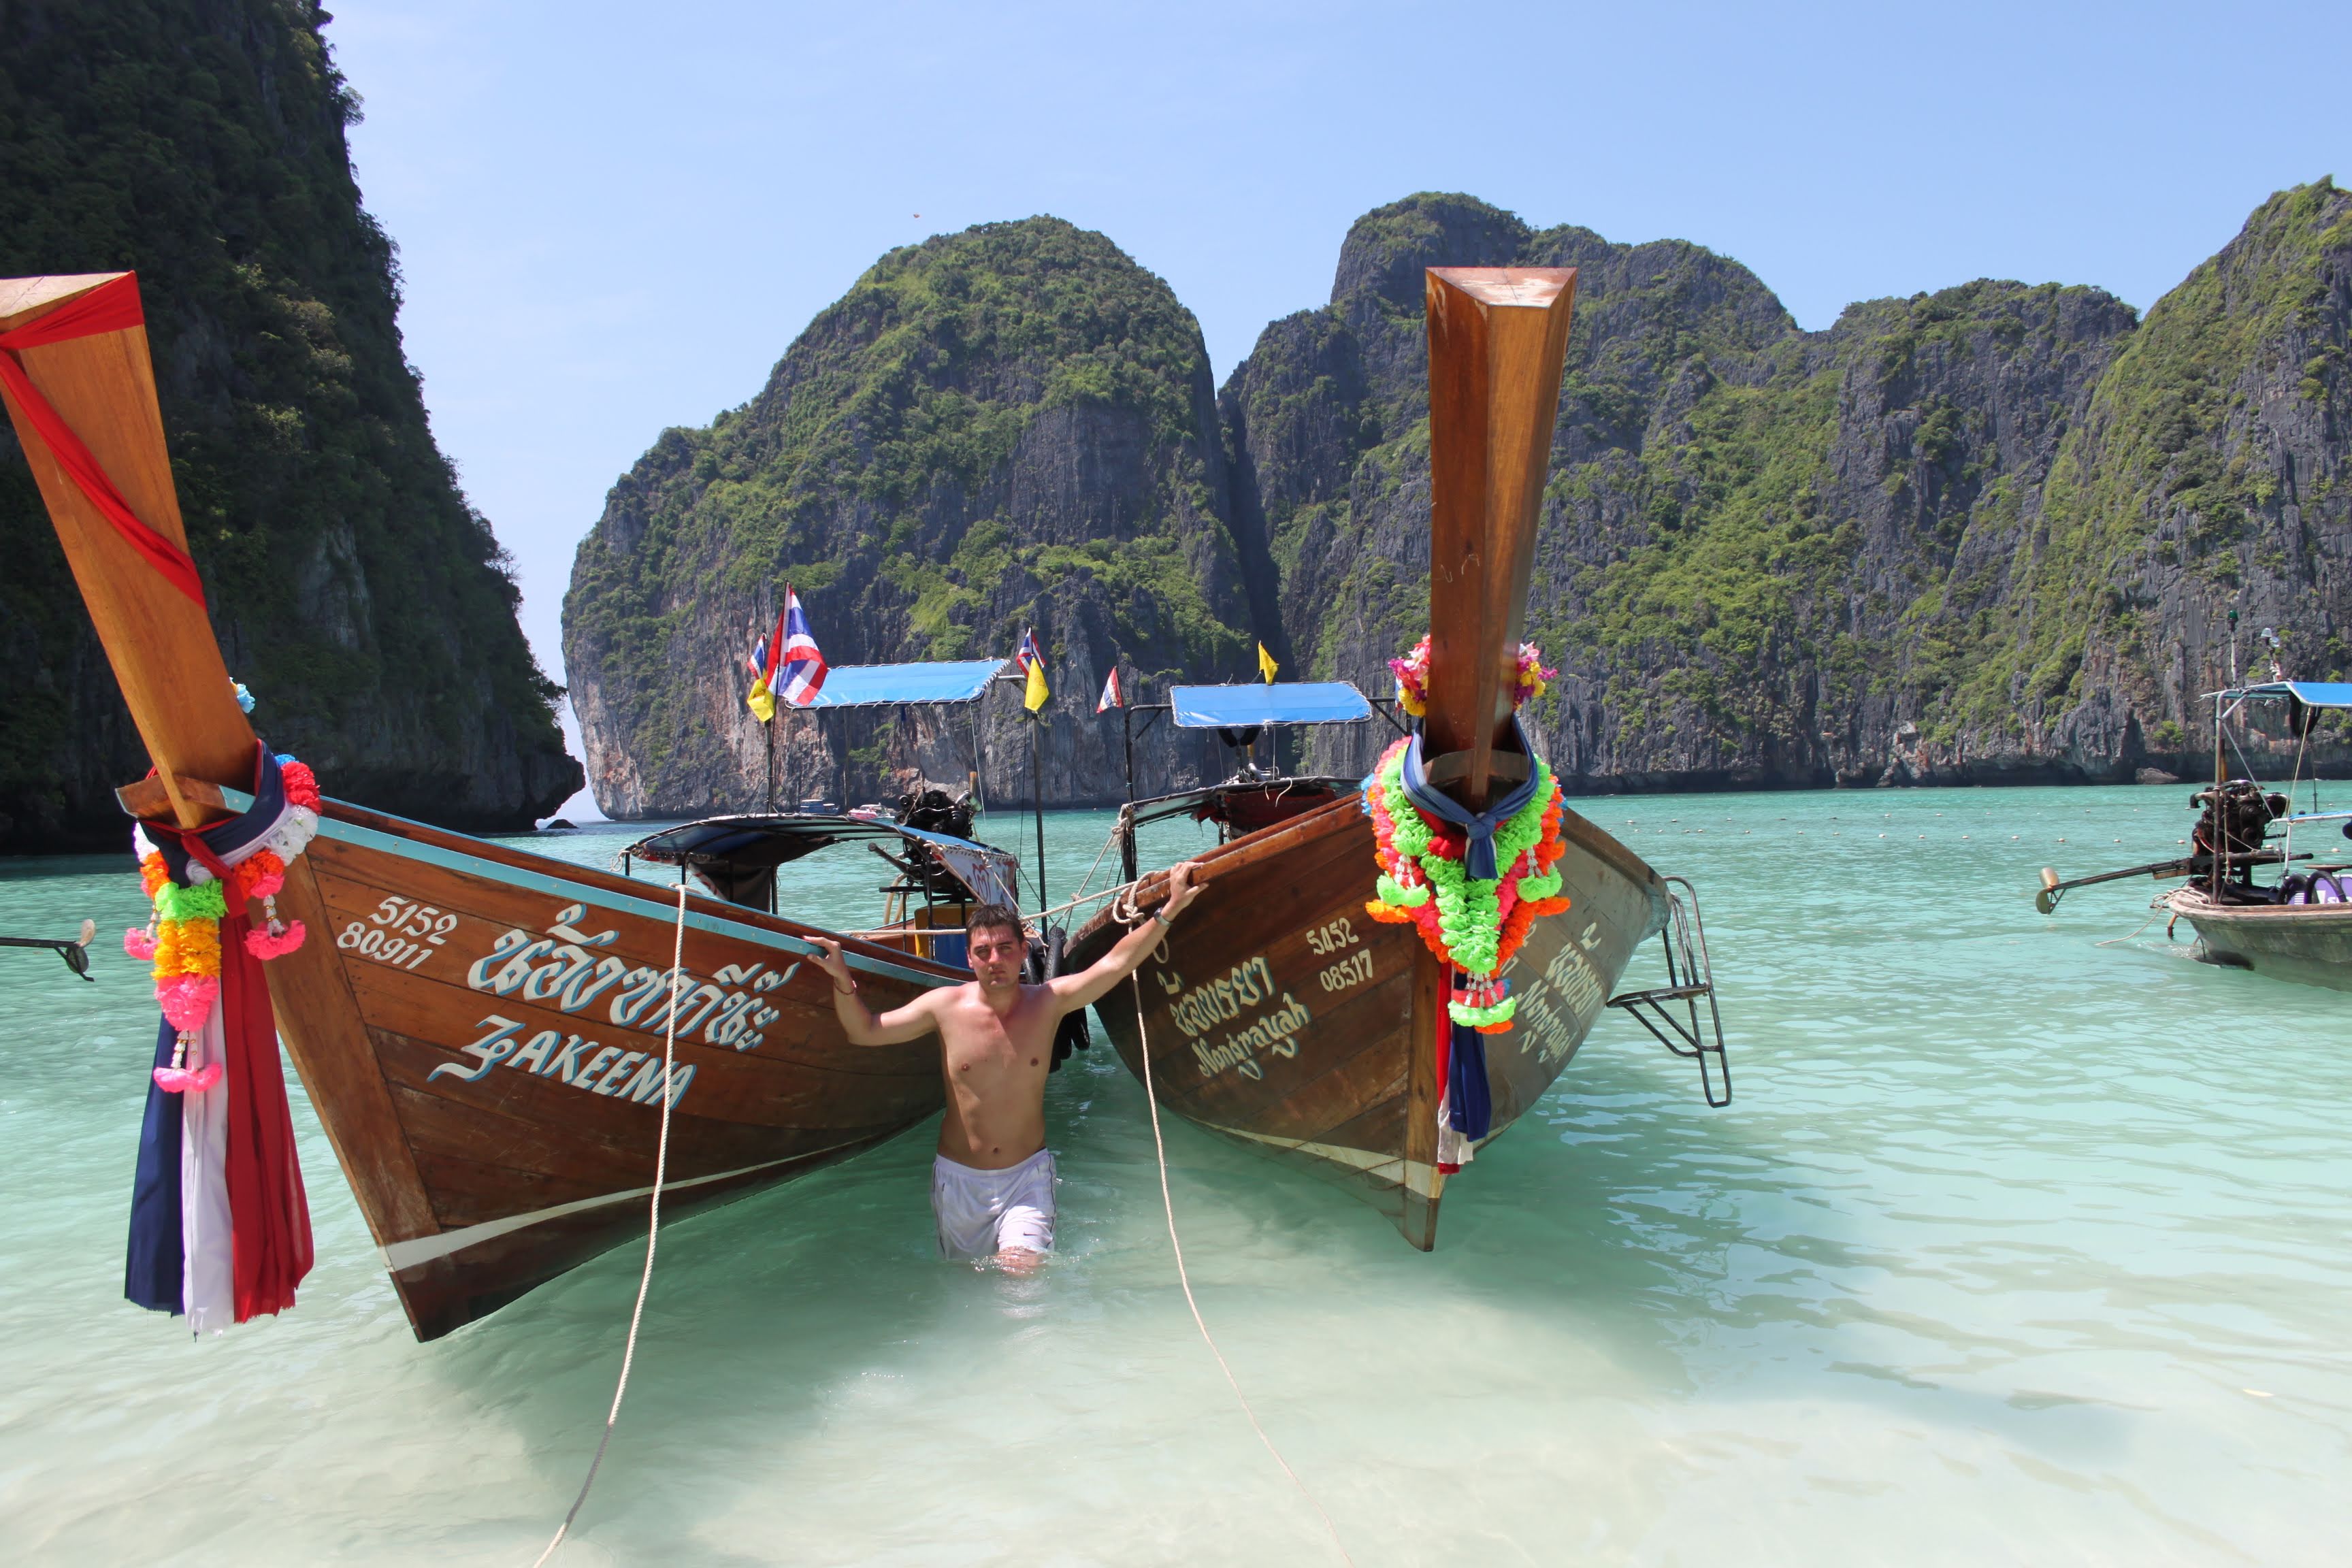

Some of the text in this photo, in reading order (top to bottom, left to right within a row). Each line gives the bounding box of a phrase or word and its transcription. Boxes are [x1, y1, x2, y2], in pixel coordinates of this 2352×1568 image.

[366, 896, 457, 945] 5152
[337, 922, 433, 970] 80911
[1320, 949, 1373, 992] 08517
[1192, 993, 1312, 1081] Nongrayah
[428, 1015, 697, 1110] ZAKEENA
